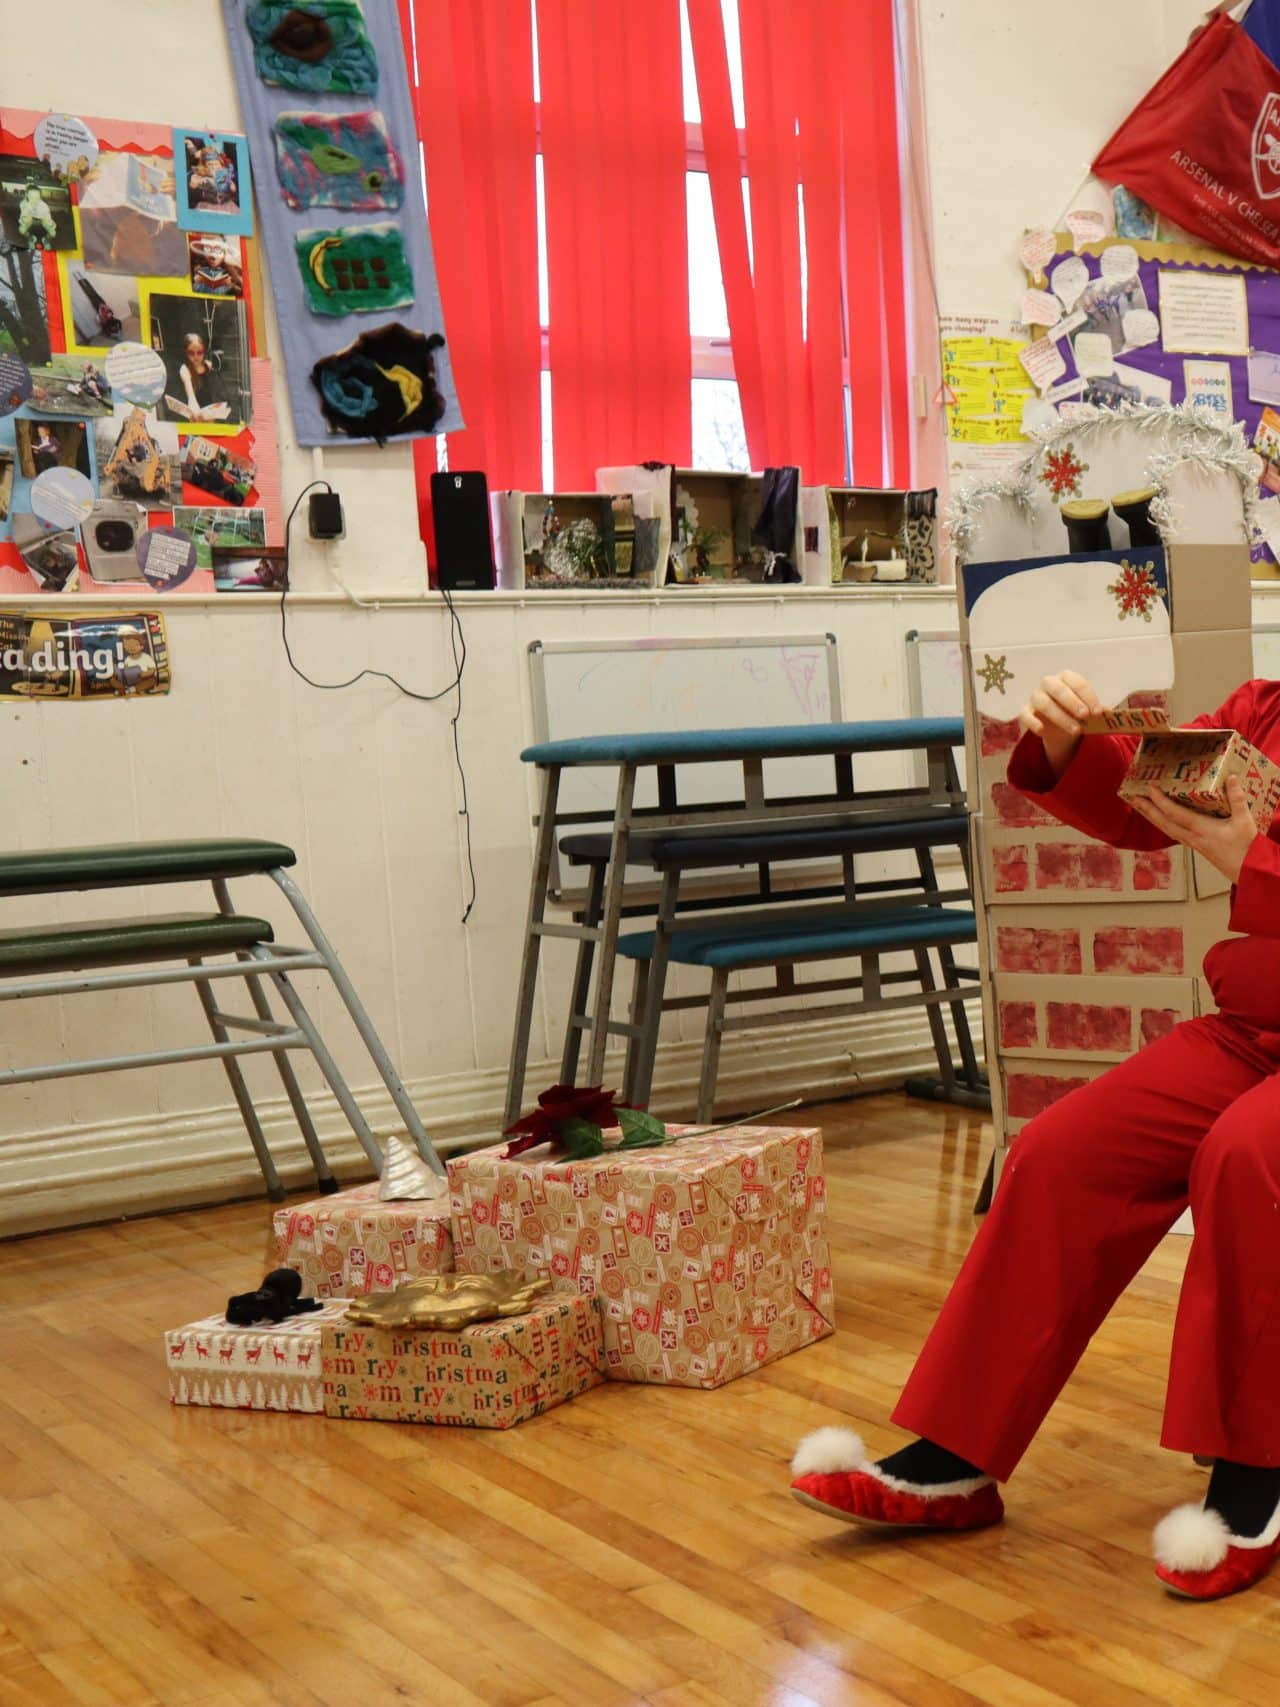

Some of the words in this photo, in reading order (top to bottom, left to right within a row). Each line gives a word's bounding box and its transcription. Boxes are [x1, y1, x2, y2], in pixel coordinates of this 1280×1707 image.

[1170, 150, 1224, 199] ARSENAL
[1226, 191, 1238, 206] V
[1237, 201, 1280, 241] CHELSEA
[0, 641, 125, 679] ading!
